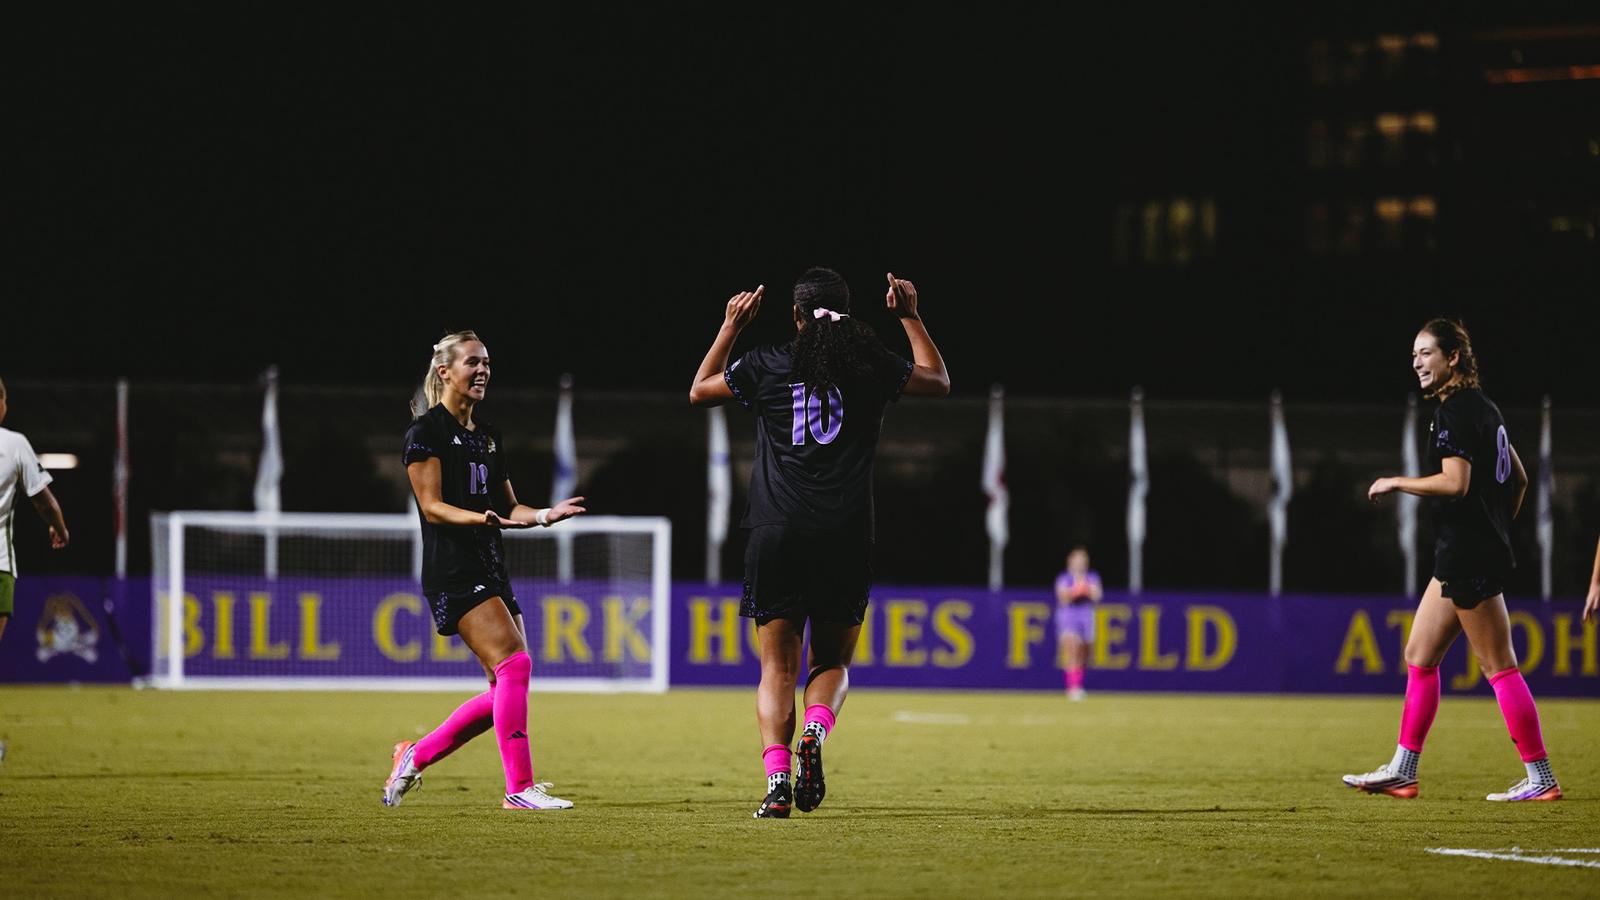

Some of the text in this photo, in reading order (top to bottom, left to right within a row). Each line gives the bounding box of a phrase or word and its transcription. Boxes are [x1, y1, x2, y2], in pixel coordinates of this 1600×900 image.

[789, 382, 843, 445] 10
[1496, 424, 1512, 484] 8
[158, 591, 340, 660] BILL
[373, 592, 651, 664] CLRK
[688, 596, 975, 669] HES
[1007, 602, 1238, 672] FELD
